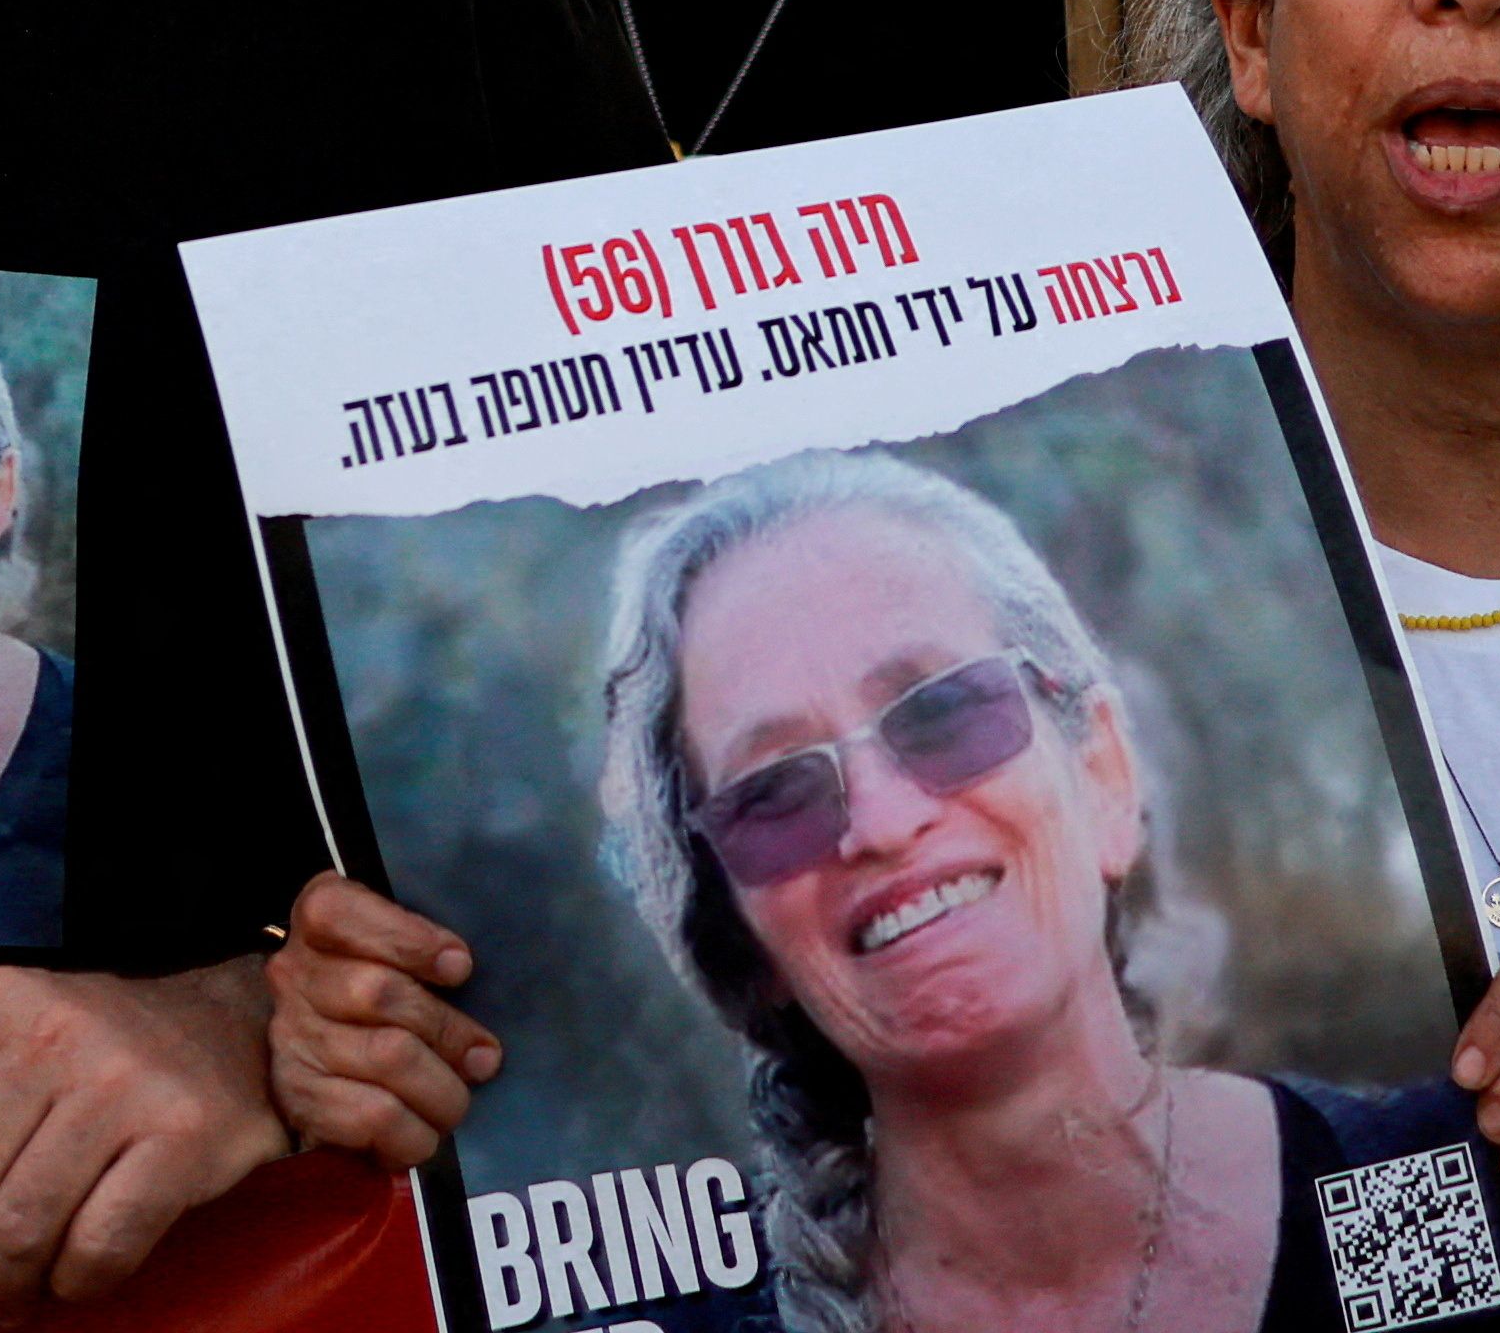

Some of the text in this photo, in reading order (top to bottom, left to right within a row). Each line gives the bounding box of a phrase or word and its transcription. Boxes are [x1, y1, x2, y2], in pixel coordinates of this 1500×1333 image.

[542, 192, 920, 335] מיה גורן (56)
[341, 246, 1183, 469] נרצחה על ידי חמאס. עדיין חטופה בעזה.
[467, 1157, 759, 1332] BRING
